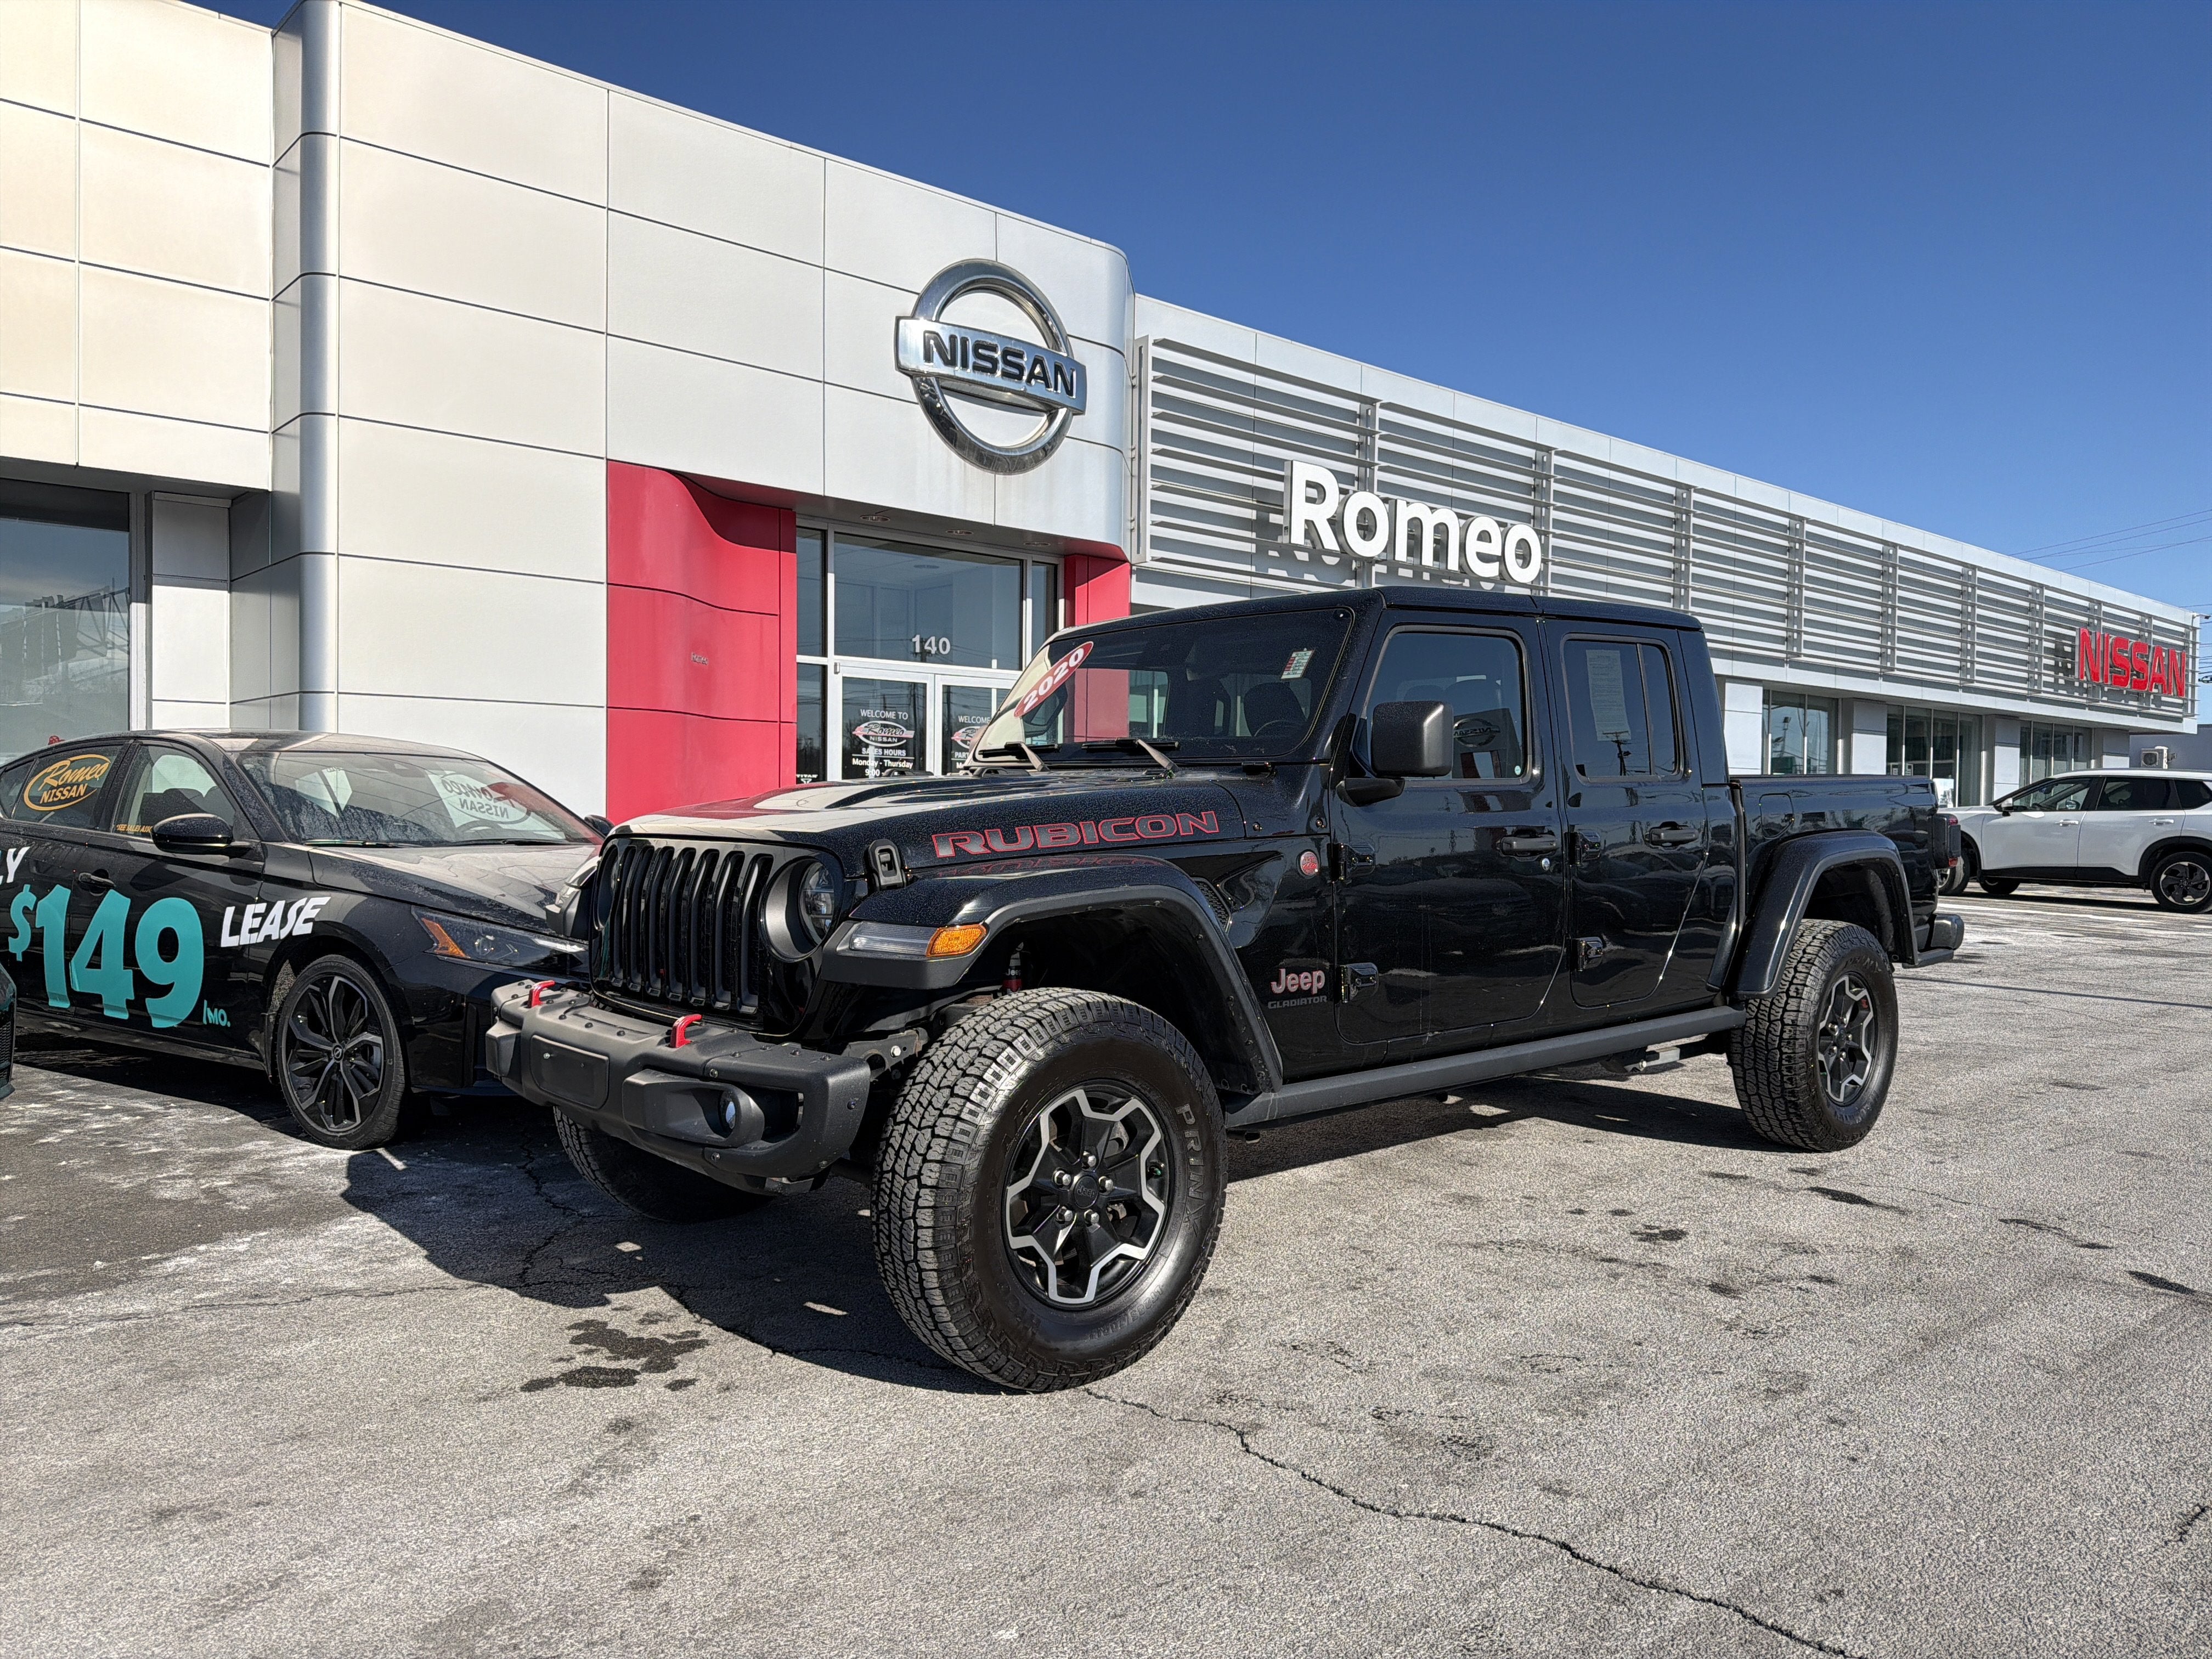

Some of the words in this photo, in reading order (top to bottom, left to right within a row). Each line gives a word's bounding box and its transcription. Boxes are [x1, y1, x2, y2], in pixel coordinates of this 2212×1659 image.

[923, 330, 1076, 399] NISSAN
[1285, 460, 1542, 584] Romeo
[912, 634, 951, 654] 140
[2076, 627, 2186, 697] NISSAN
[1023, 648, 1084, 713] 2020
[860, 709, 896, 719] WELCOME
[897, 712, 909, 720] TO
[958, 715, 990, 724] WELCOME
[865, 723, 905, 736] Romeo
[38, 760, 110, 791] Romeo
[852, 758, 878, 767] Monday
[884, 759, 913, 769] Thursday
[865, 769, 880, 777] 9:00
[40, 783, 88, 804] NISSAN
[932, 811, 1219, 858] RUBICON
[0, 847, 30, 883] Y
[221, 897, 331, 947] LEASE
[8, 884, 204, 1028] $149
[1270, 968, 1325, 995] Jeep
[203, 1000, 230, 1028] /MO.
[1267, 995, 1327, 1009] GLADIATOR
[1175, 1103, 1206, 1237] PRINX
[1076, 1186, 1096, 1198] Jeep
